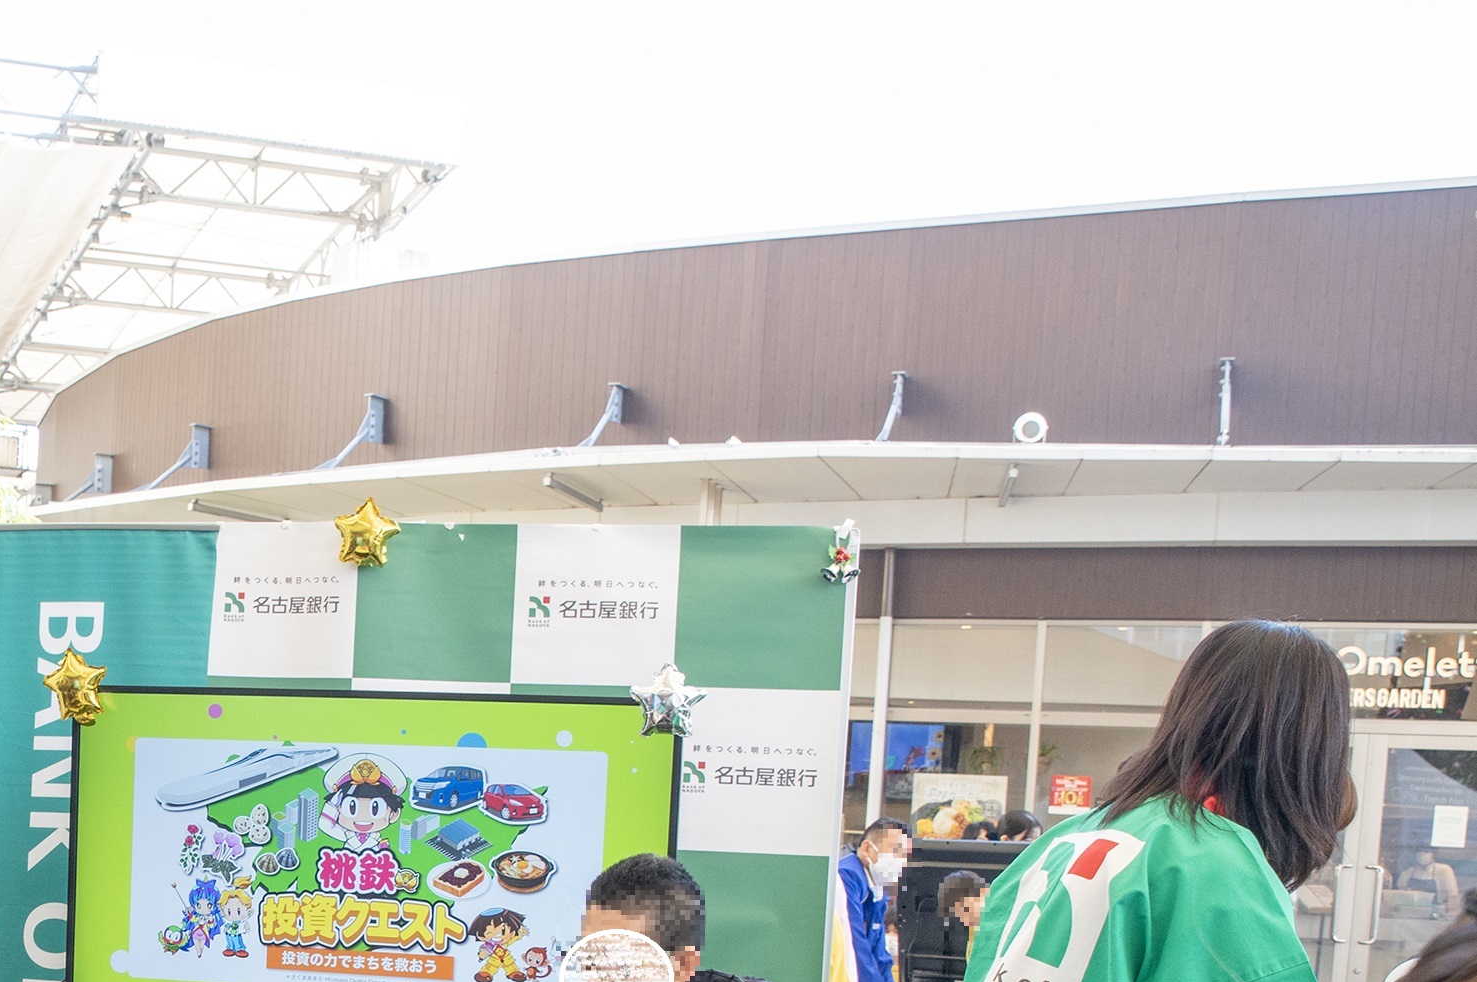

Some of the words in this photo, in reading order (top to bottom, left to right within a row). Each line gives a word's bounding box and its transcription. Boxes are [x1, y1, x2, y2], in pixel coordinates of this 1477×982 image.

[253, 596, 340, 614] 名古屋銀行
[559, 600, 659, 620] 名古屋銀行
[1337, 645, 1477, 679] Omelet
[714, 766, 818, 788] 名古屋銀行
[319, 851, 396, 892] 桃鉄
[262, 894, 465, 951] 投資クエスト
[281, 950, 438, 974] 投資の力でまちを救おう
